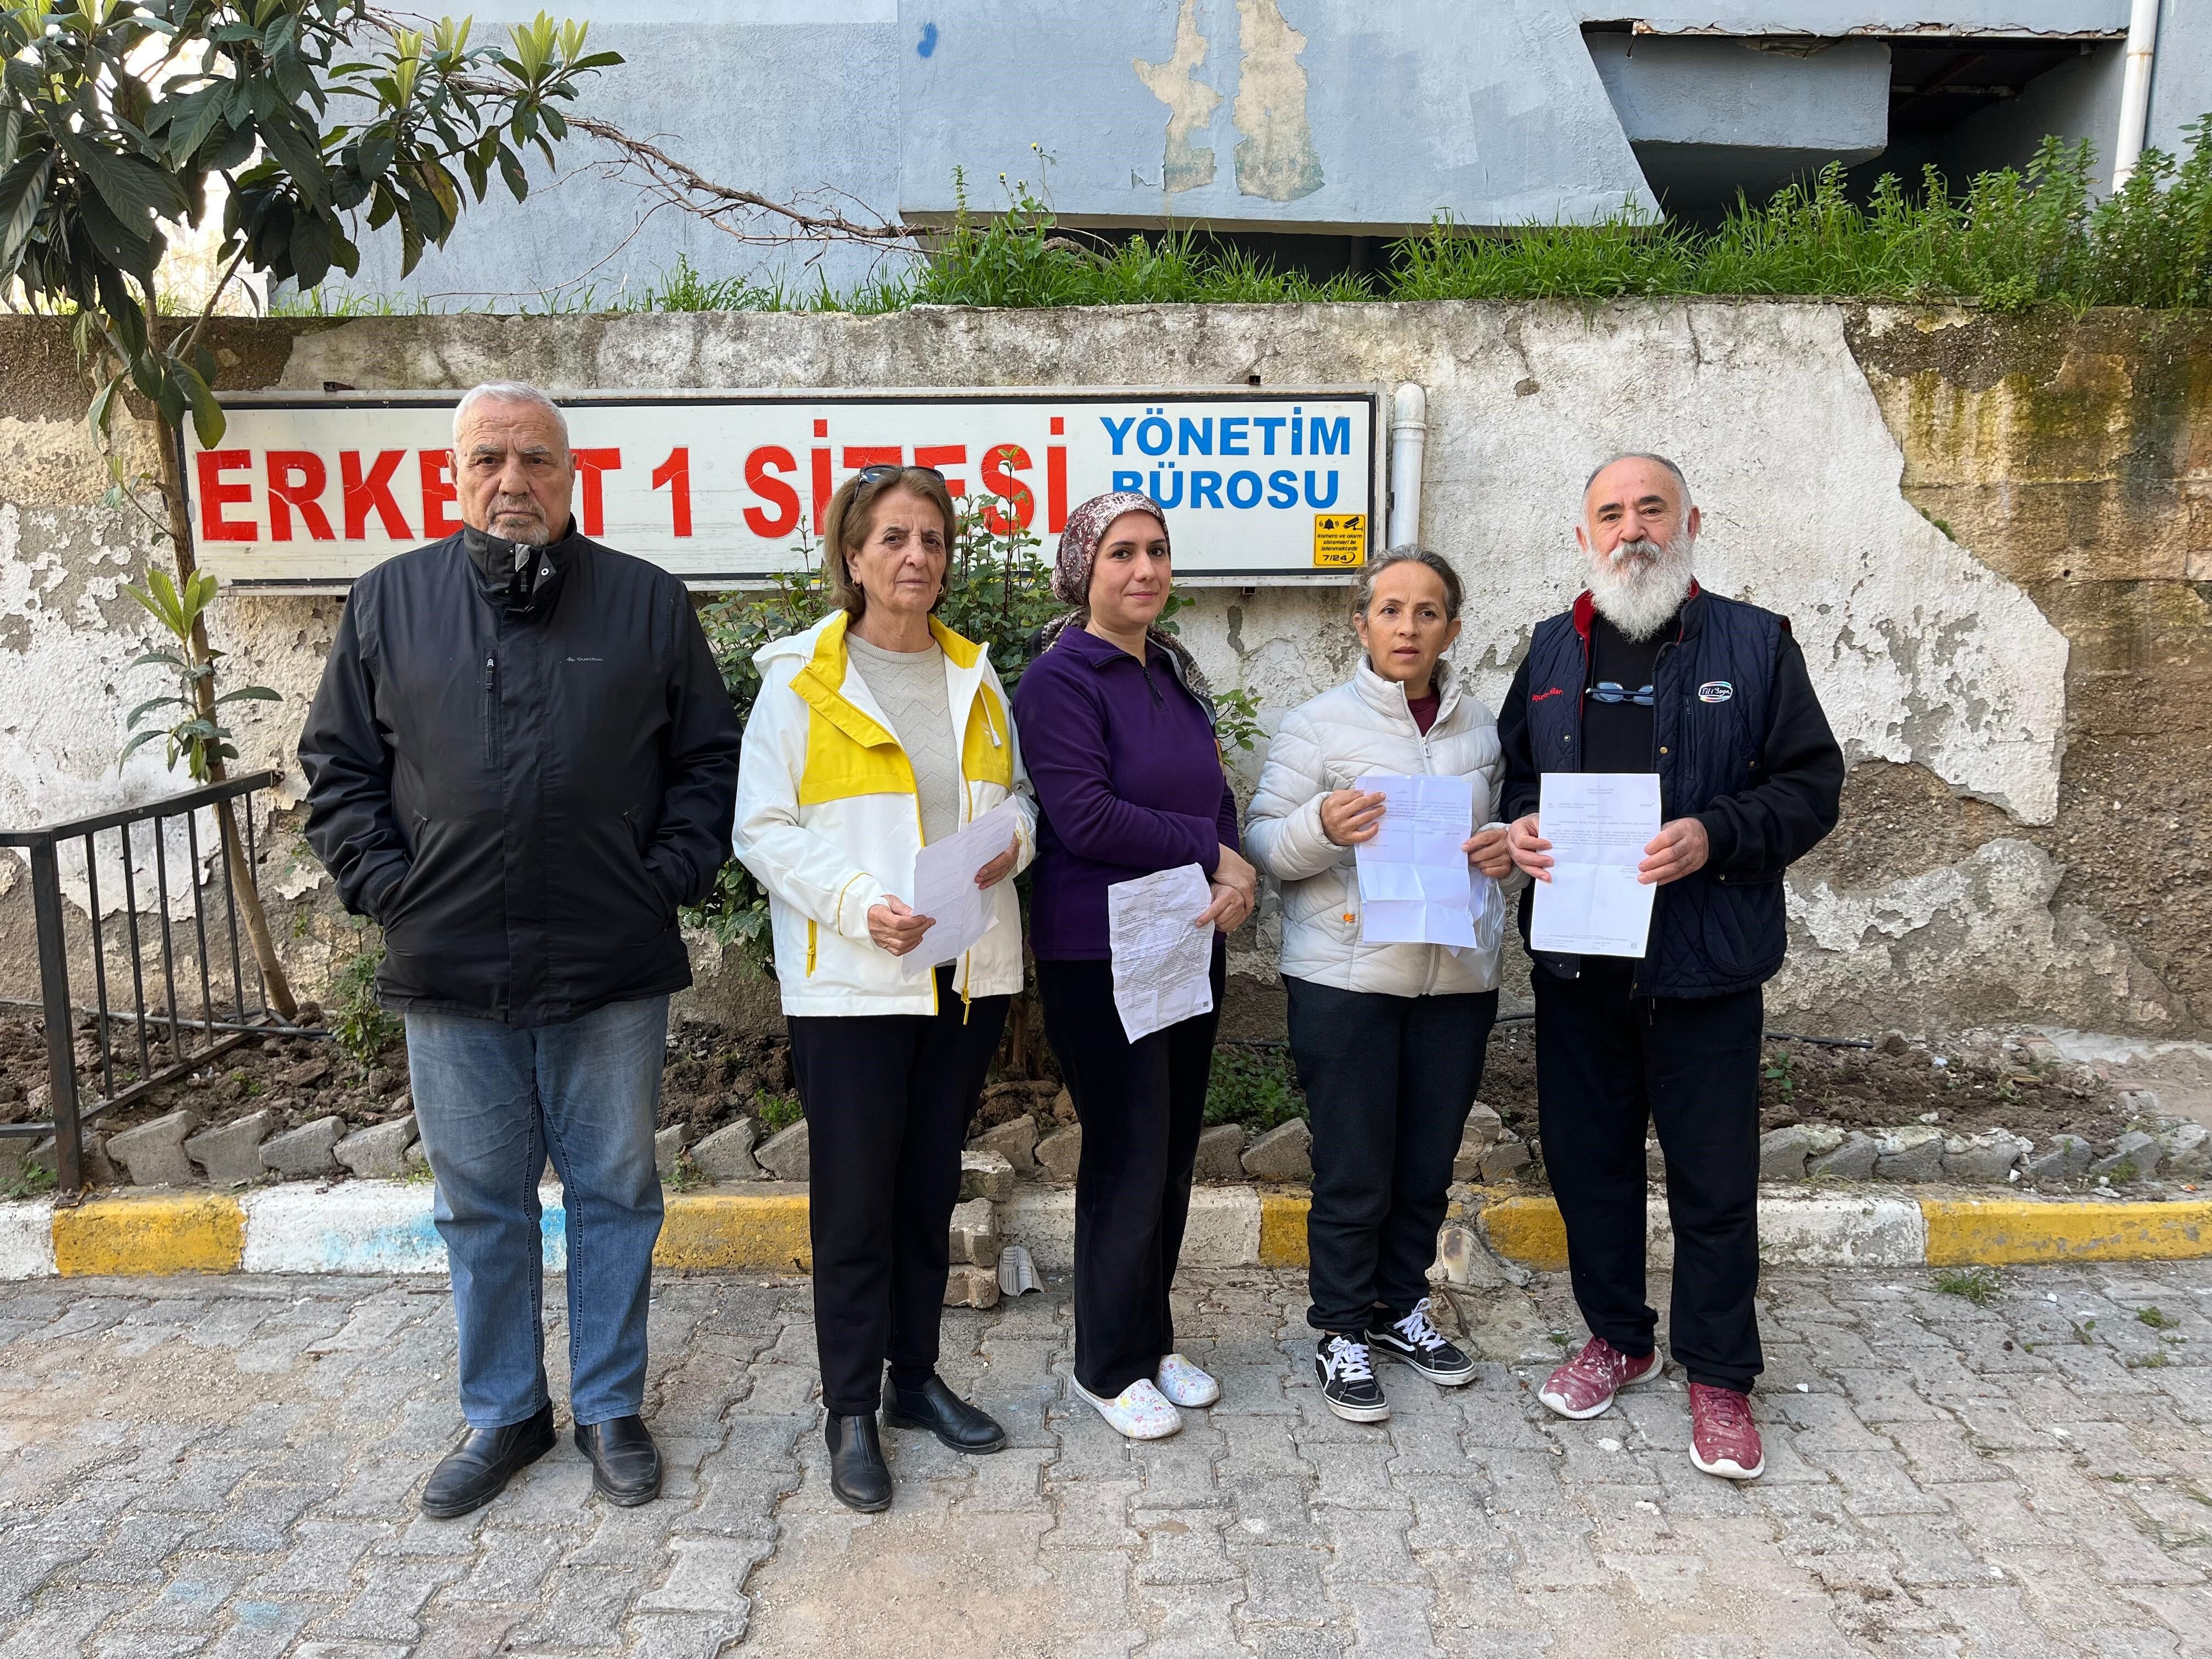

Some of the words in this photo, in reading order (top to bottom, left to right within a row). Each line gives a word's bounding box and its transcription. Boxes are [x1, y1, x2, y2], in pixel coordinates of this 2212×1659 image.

[1100, 407, 1350, 456] YÖNETİM
[197, 448, 621, 541] ERKET
[652, 447, 692, 537] 1
[1113, 461, 1339, 509] BÜROSU
